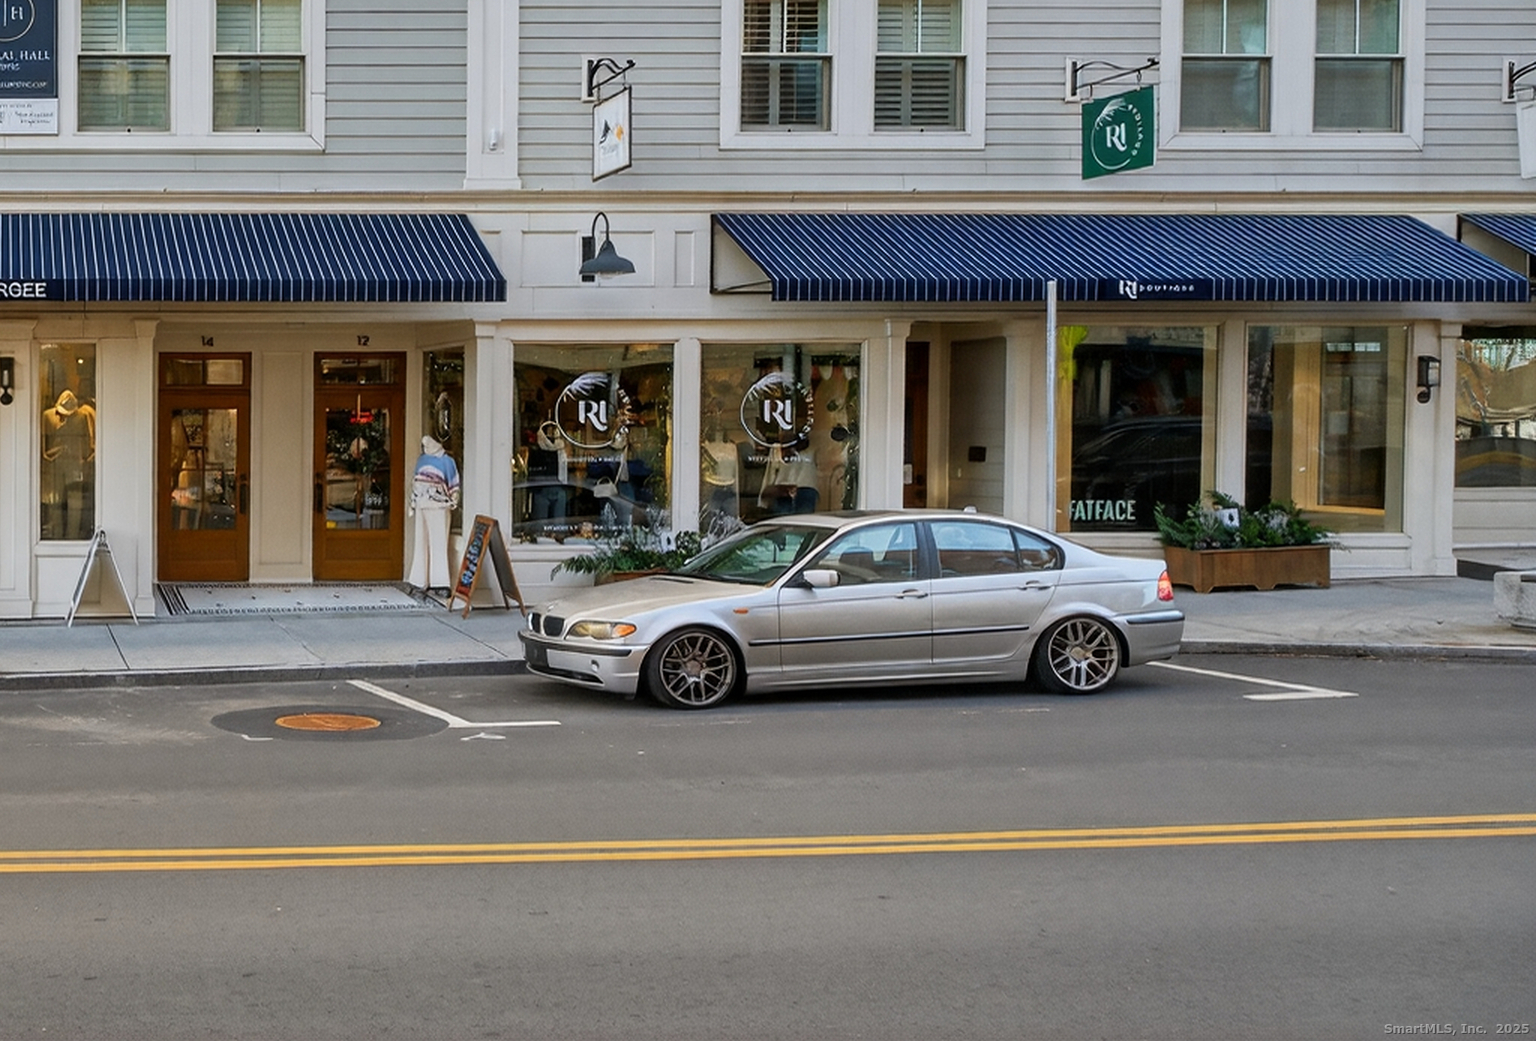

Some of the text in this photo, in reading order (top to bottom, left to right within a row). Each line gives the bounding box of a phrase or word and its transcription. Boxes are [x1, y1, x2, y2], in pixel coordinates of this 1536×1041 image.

[201, 335, 214, 347] 14
[356, 335, 370, 347] 12
[1068, 500, 1136, 521] FATFACE
